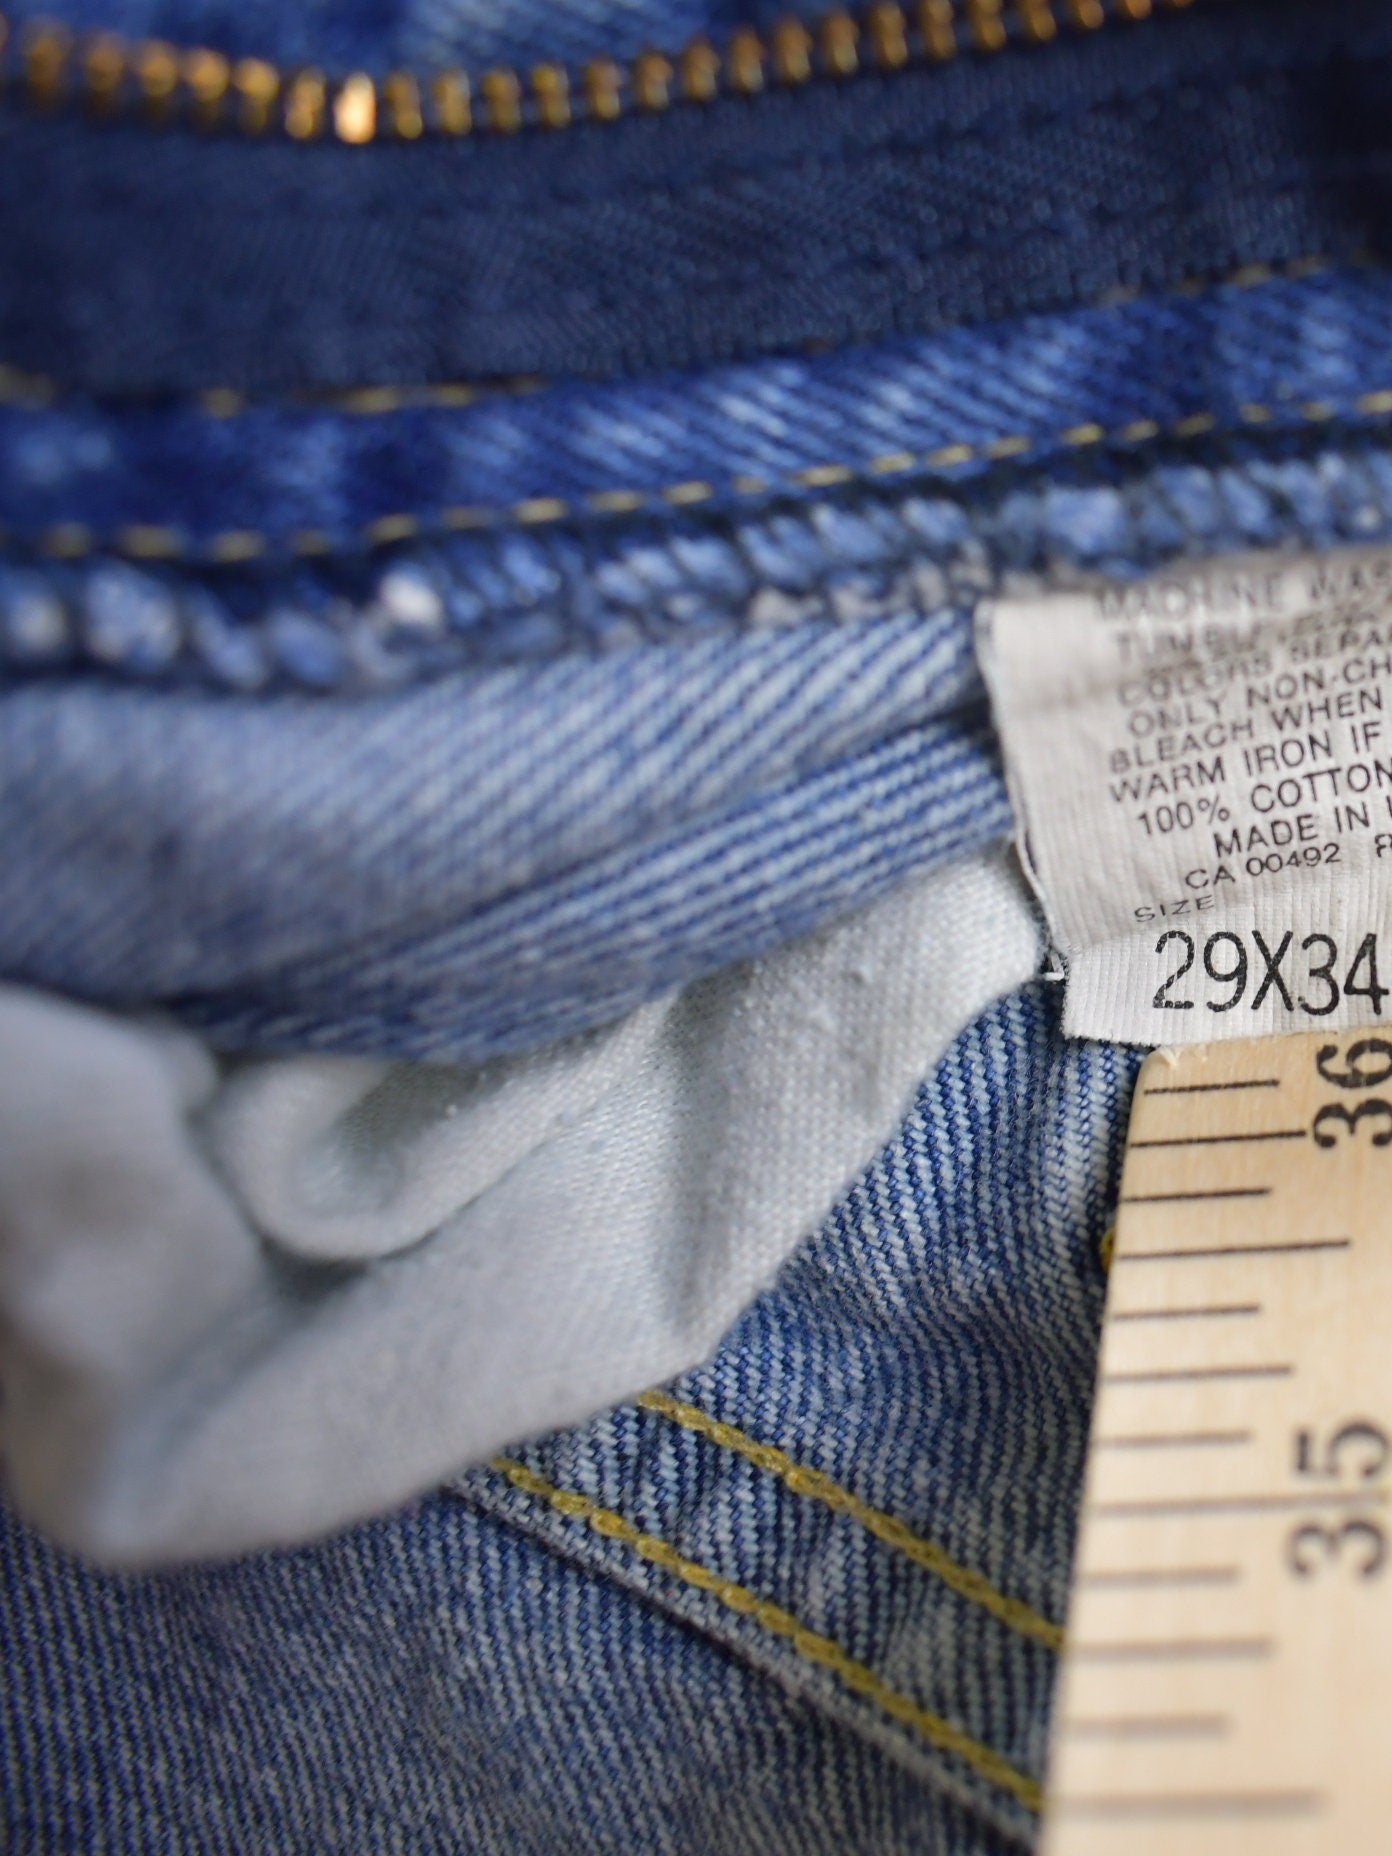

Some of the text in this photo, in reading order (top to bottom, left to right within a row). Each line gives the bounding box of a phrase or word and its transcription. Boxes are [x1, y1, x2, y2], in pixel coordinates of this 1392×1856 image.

[1109, 718, 1255, 775] BLEACH
[1270, 686, 1384, 732] WHEN
[1128, 690, 1228, 739] ONLY
[1109, 755, 1227, 804] WARM
[1242, 730, 1333, 777] IRON
[1350, 720, 1383, 754] IF
[1137, 793, 1231, 836] 100%
[1212, 812, 1319, 859] MADE
[1333, 800, 1371, 835] IN
[1184, 864, 1237, 890] CA
[1245, 842, 1342, 877] 00492
[1133, 894, 1217, 924] SIZE
[1152, 929, 1391, 1017] 29X34
